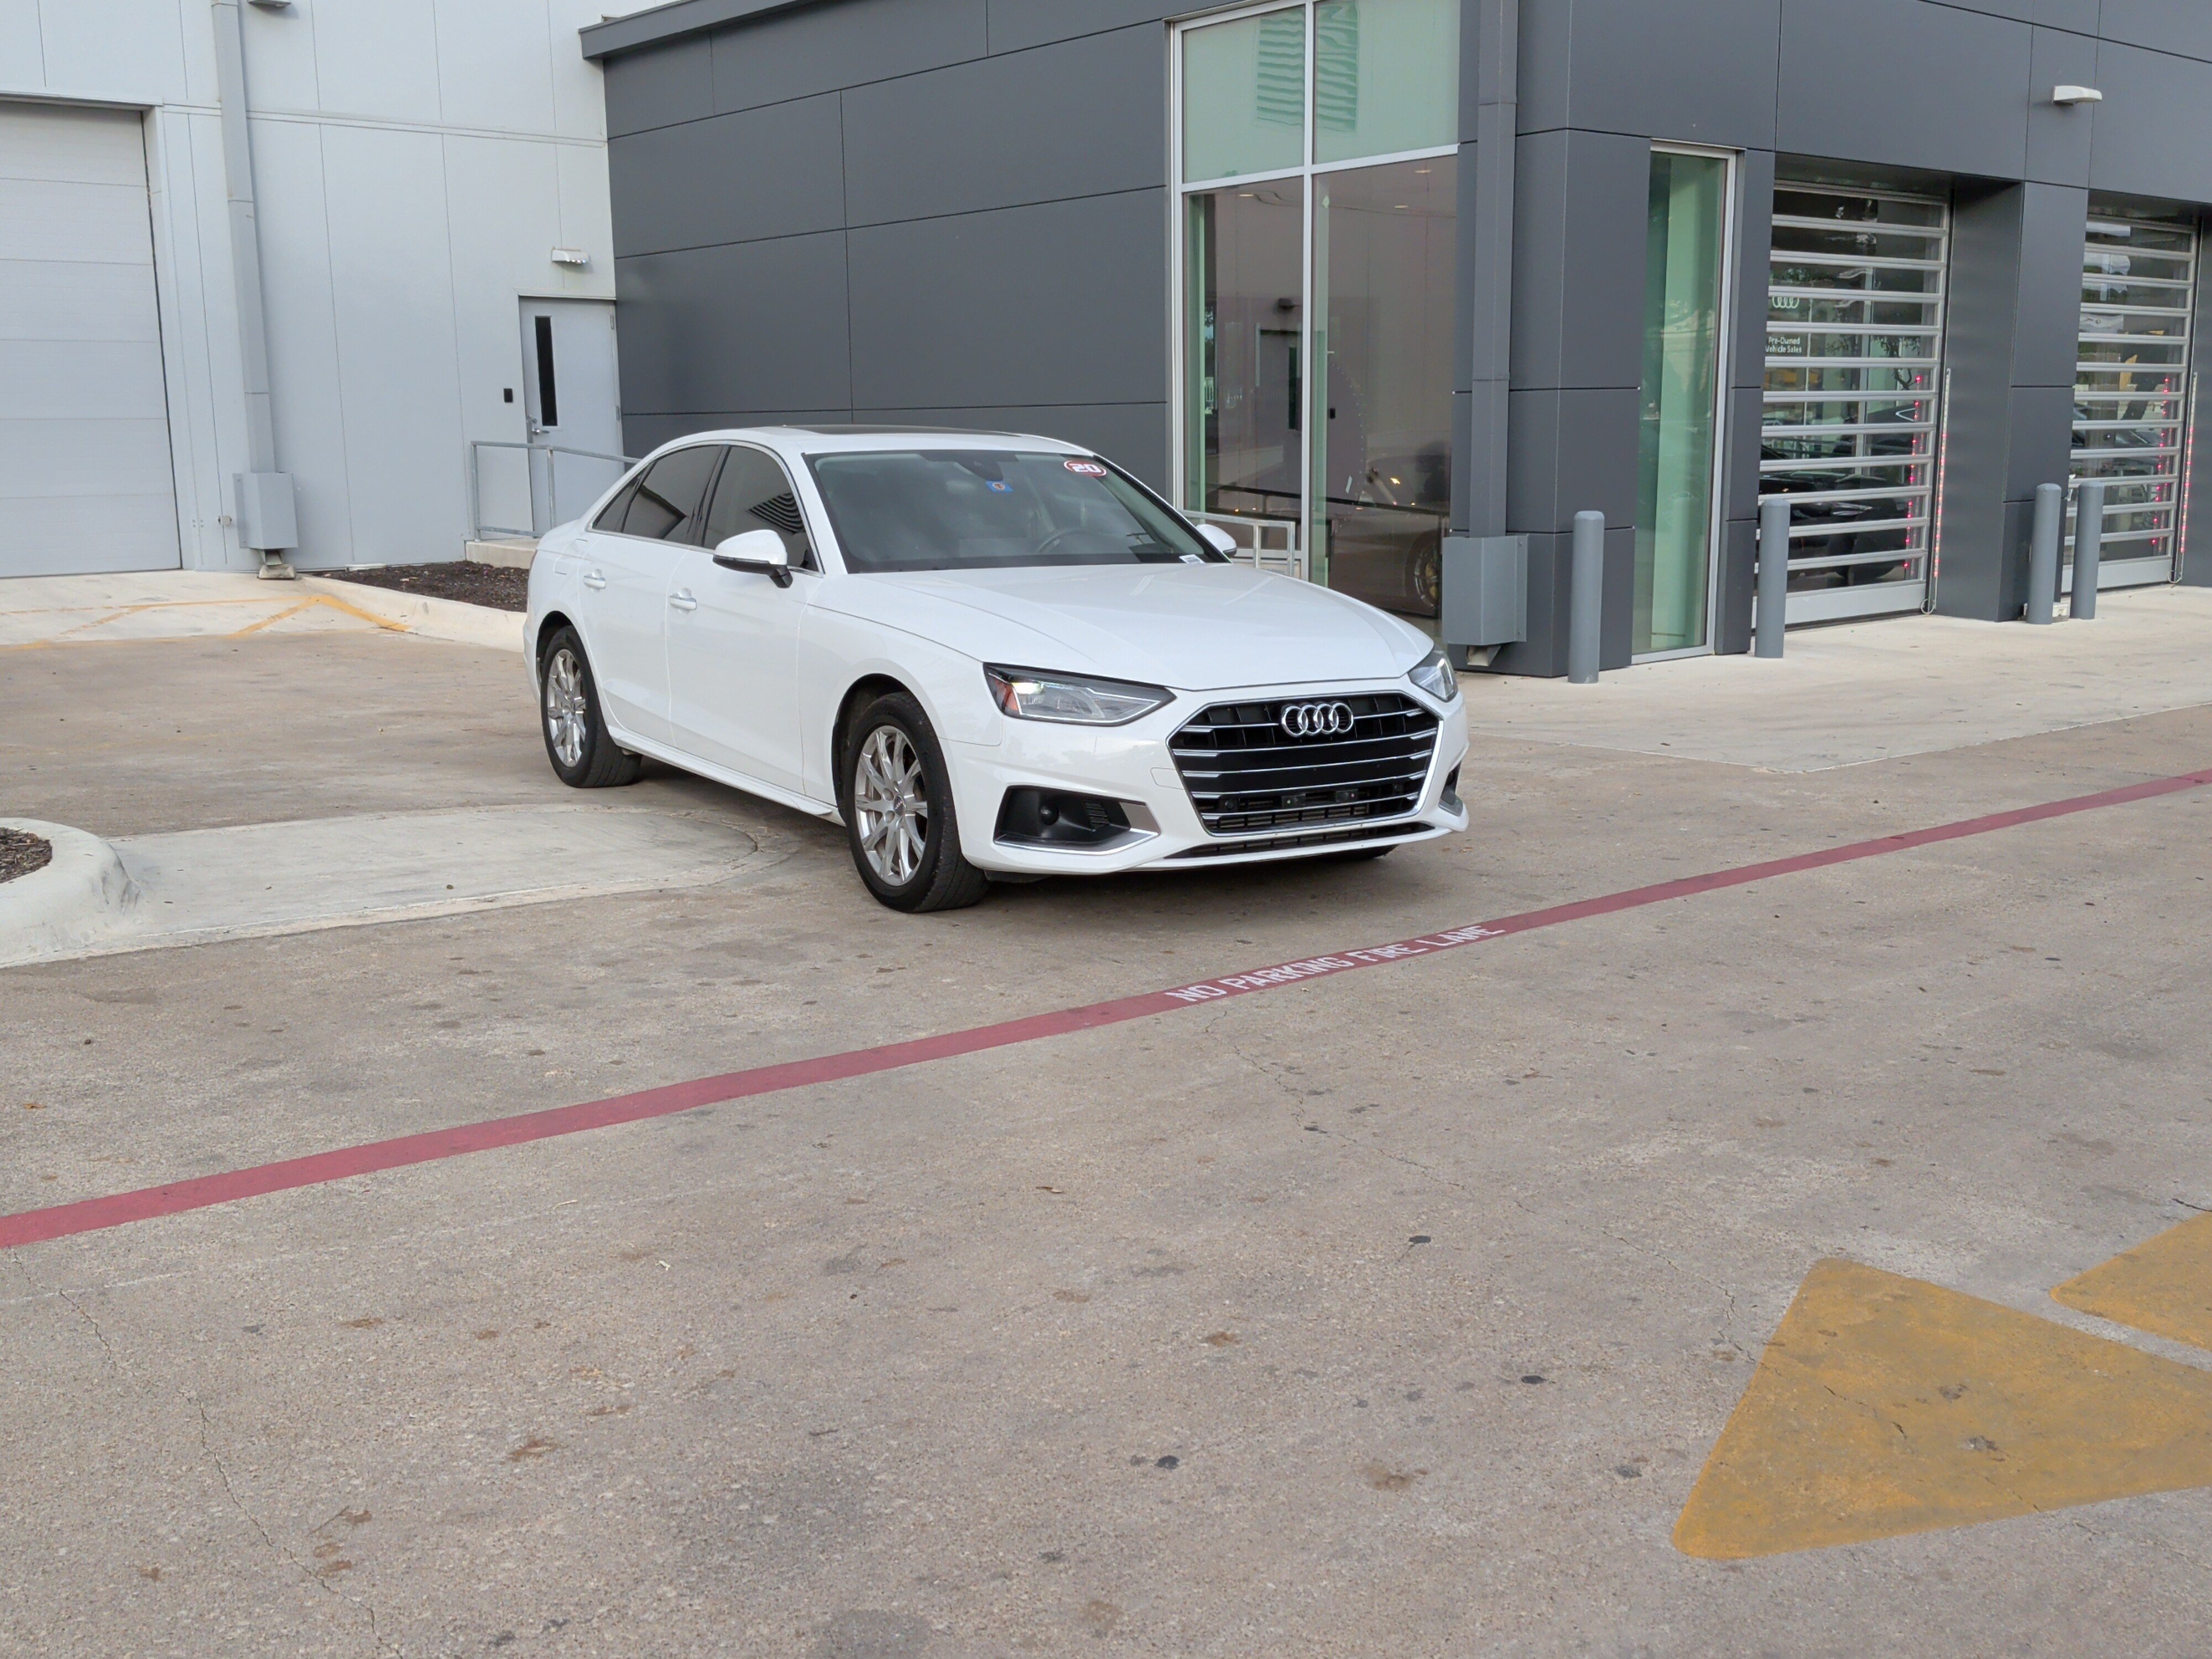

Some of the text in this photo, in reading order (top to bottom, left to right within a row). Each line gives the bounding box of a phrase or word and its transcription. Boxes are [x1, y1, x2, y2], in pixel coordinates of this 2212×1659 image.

[1768, 336, 1801, 345] Pre-Owned
[1787, 345, 1802, 353] Sales
[1068, 463, 1102, 473] 20
[1164, 925, 1506, 1002] NO PARKING FIRE LANE
